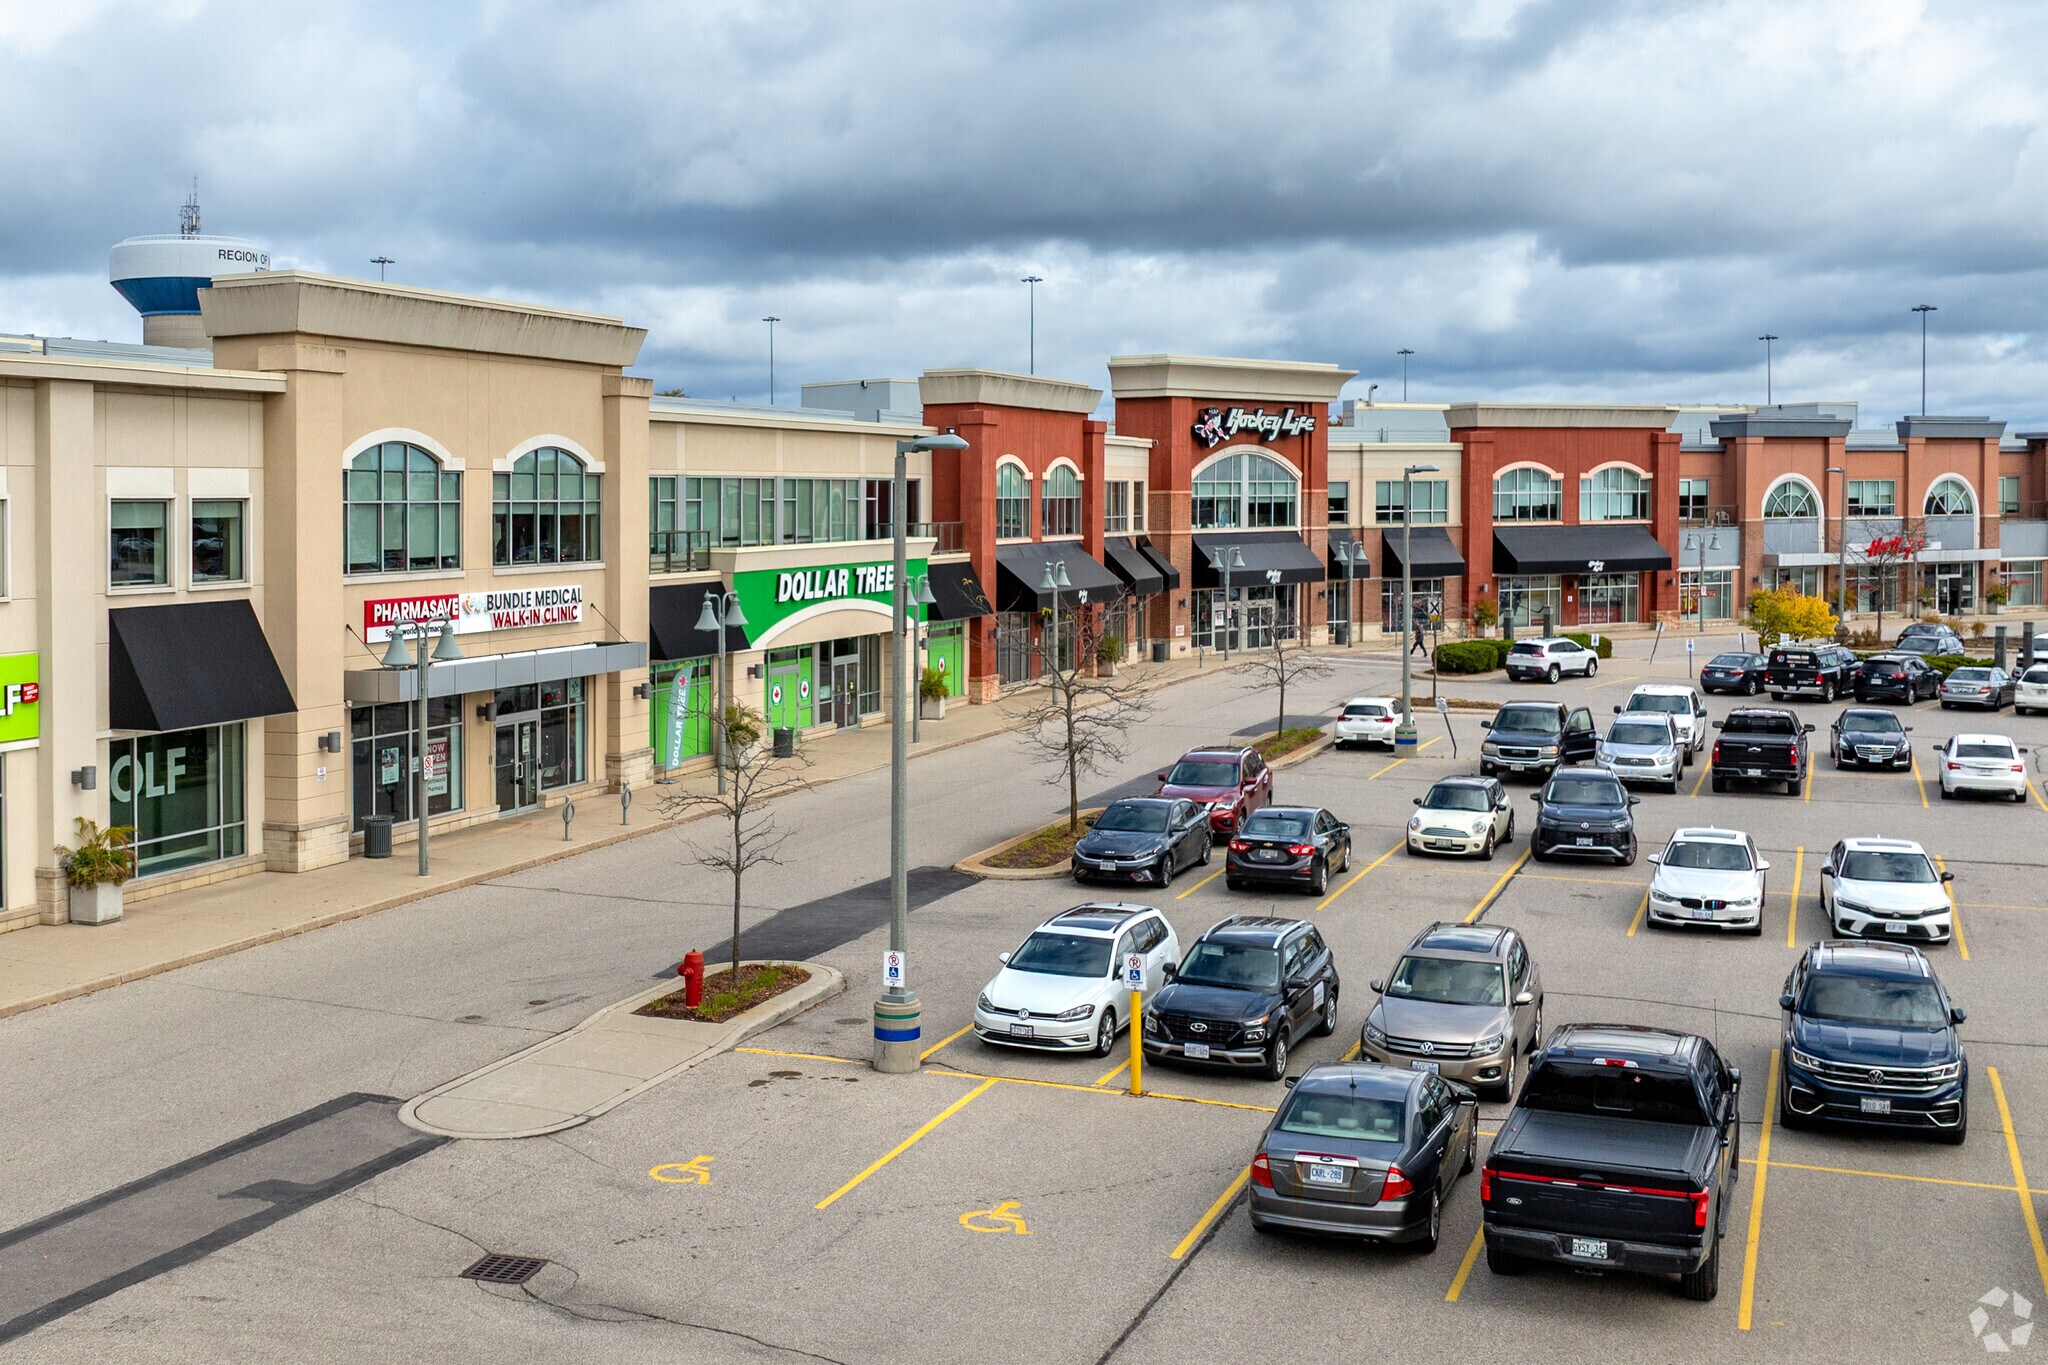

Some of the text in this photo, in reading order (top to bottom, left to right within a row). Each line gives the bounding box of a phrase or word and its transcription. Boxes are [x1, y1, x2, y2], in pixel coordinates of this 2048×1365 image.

[218, 249, 258, 263] REGION
[778, 564, 894, 602] DOLLAR TREE
[373, 597, 459, 623] PHARMASAVE
[486, 587, 583, 612] BUNDLE MEDICAL
[492, 605, 578, 629] WALK-IN CLINIC
[672, 719, 685, 767] DOLLAR
